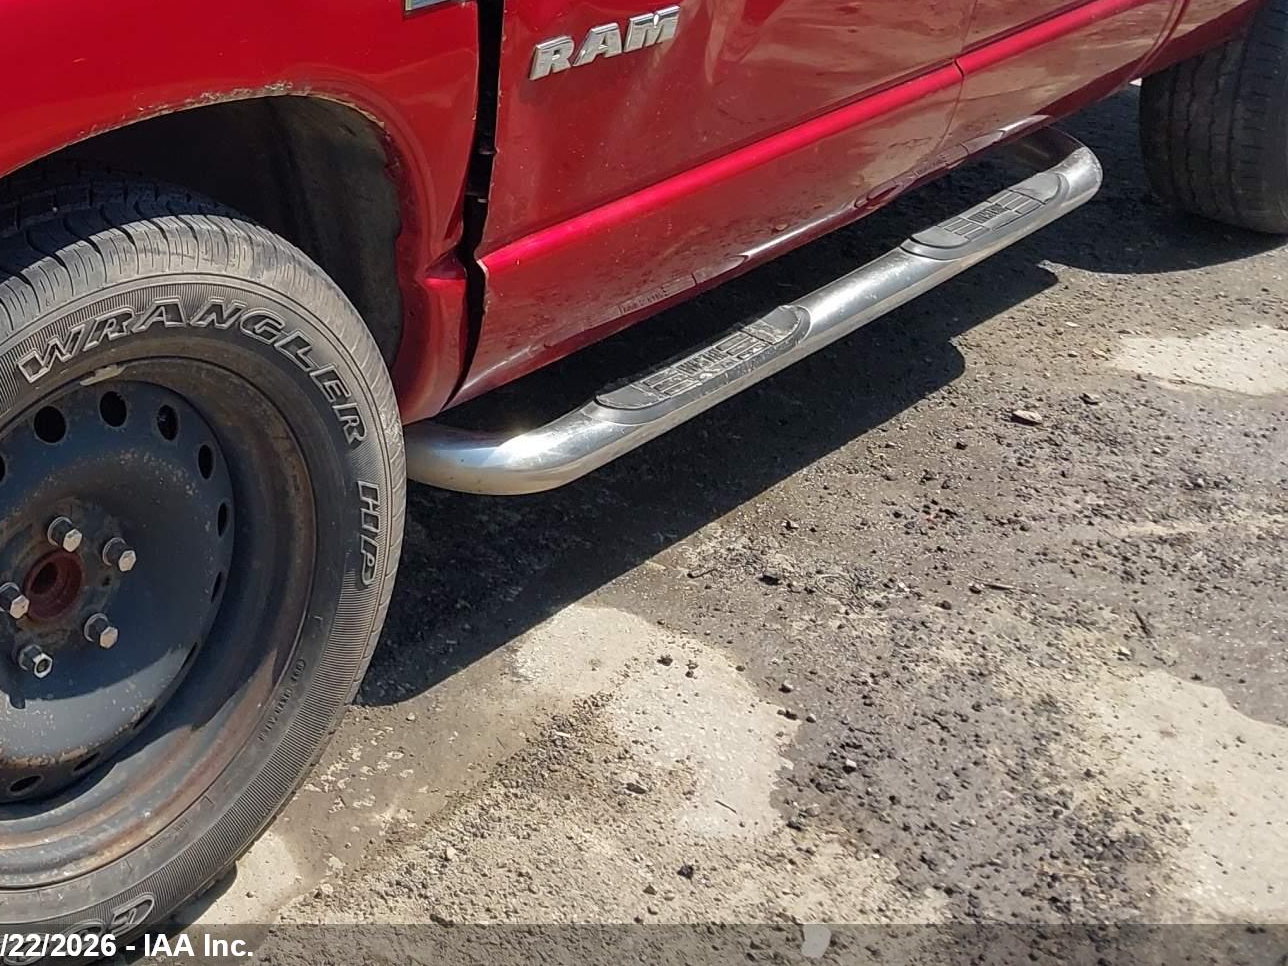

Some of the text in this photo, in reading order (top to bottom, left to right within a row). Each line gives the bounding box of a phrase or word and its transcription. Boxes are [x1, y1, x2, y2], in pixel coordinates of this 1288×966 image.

[528, 5, 681, 82] RAM
[17, 294, 382, 588] WRANGLER HP
